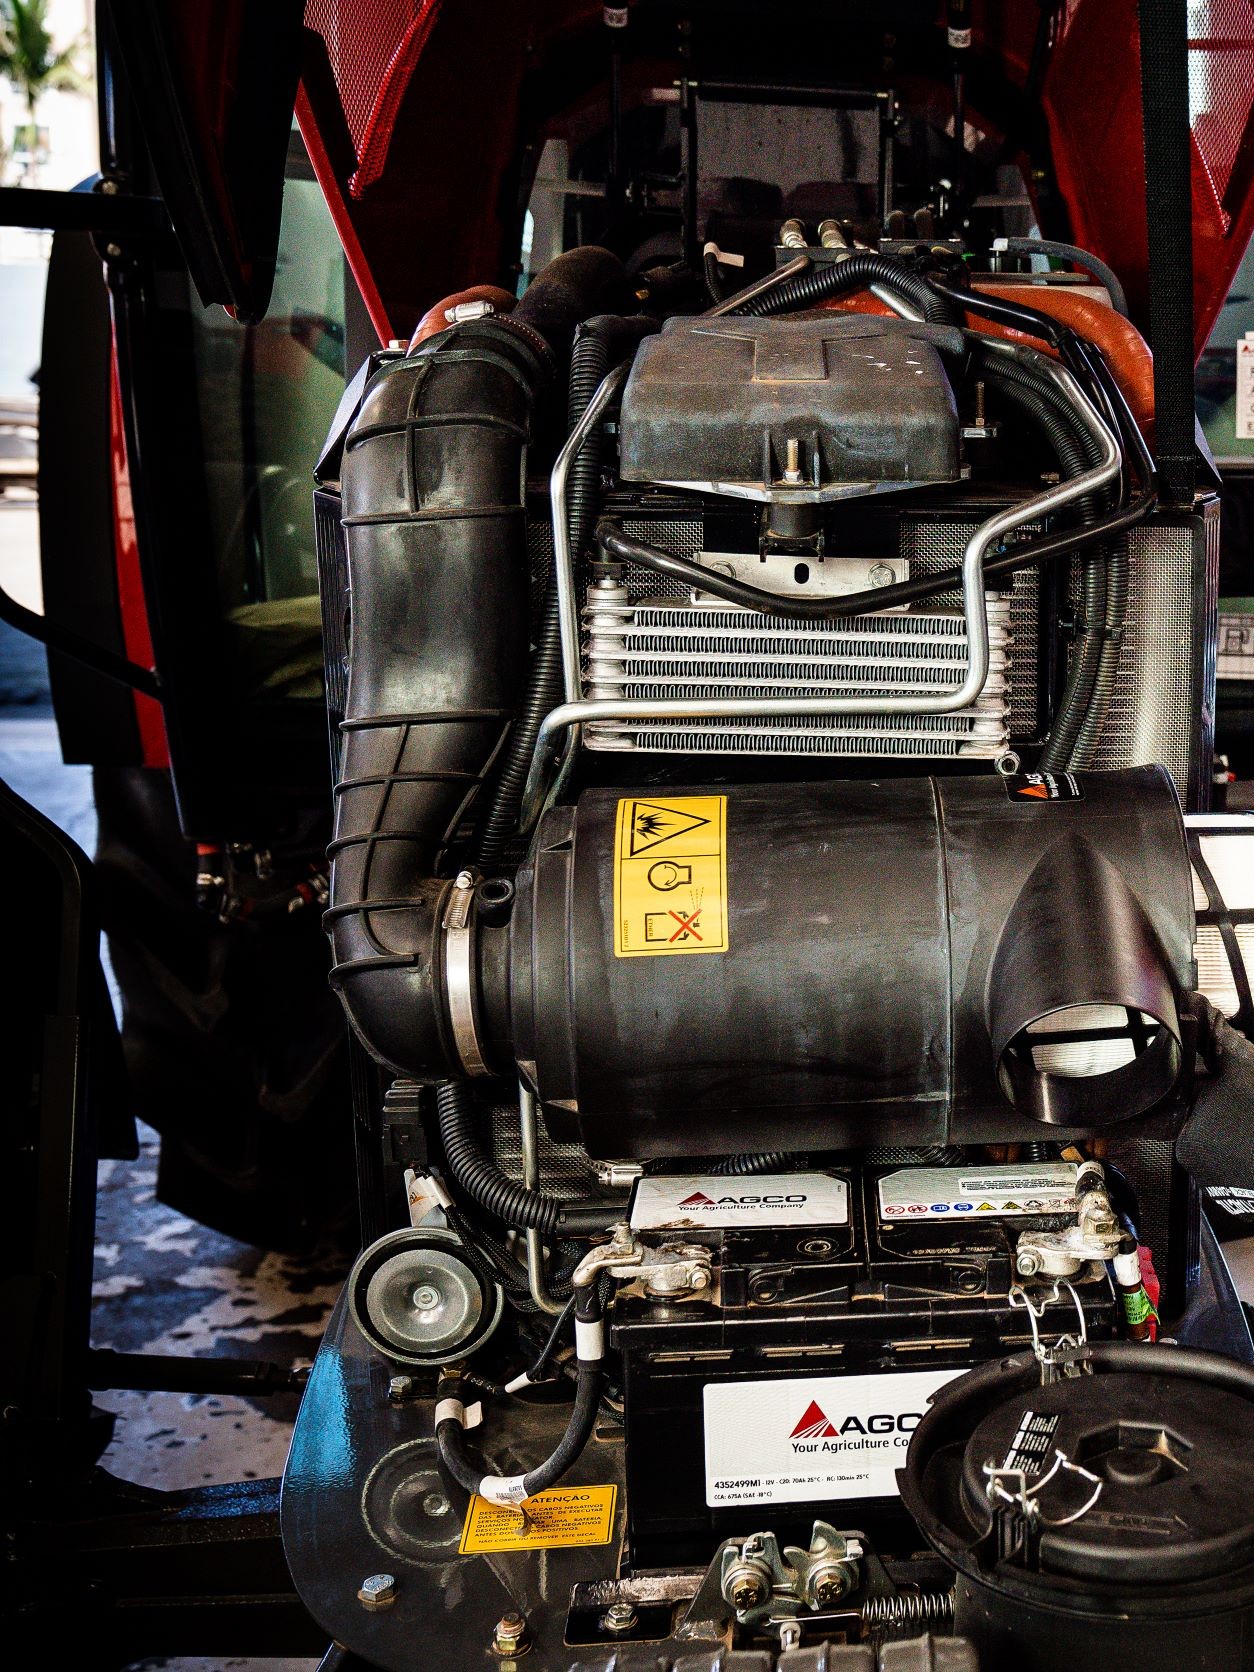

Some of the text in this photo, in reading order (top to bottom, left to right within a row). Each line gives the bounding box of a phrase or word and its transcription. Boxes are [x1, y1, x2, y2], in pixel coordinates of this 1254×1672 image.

[717, 1194, 807, 1205] AGCO
[839, 1413, 924, 1436] AGC
[791, 1437, 909, 1454] Your Agriculture Co
[714, 1479, 761, 1489] 4352499M1
